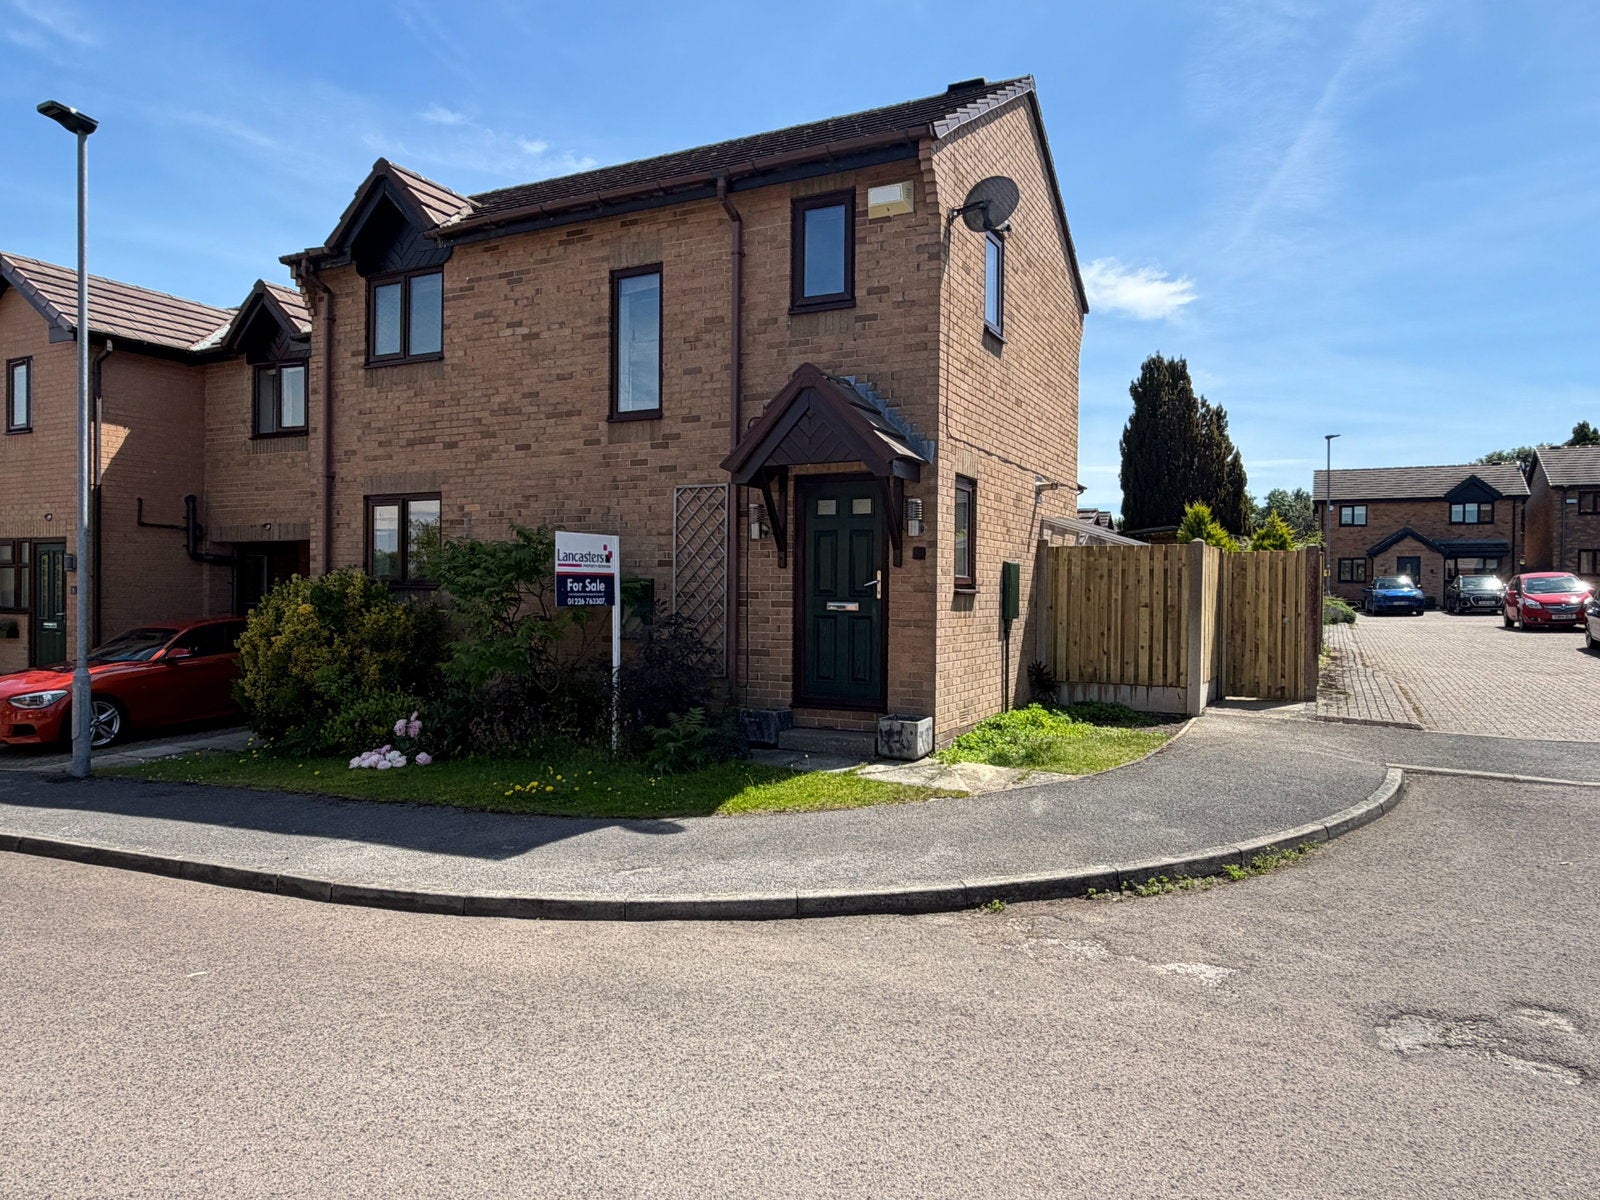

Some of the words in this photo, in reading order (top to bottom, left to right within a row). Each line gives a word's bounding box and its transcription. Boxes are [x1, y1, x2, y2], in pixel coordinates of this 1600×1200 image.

[557, 548, 604, 563] Lancasters
[567, 578, 583, 592] For
[585, 578, 606, 592] Sale
